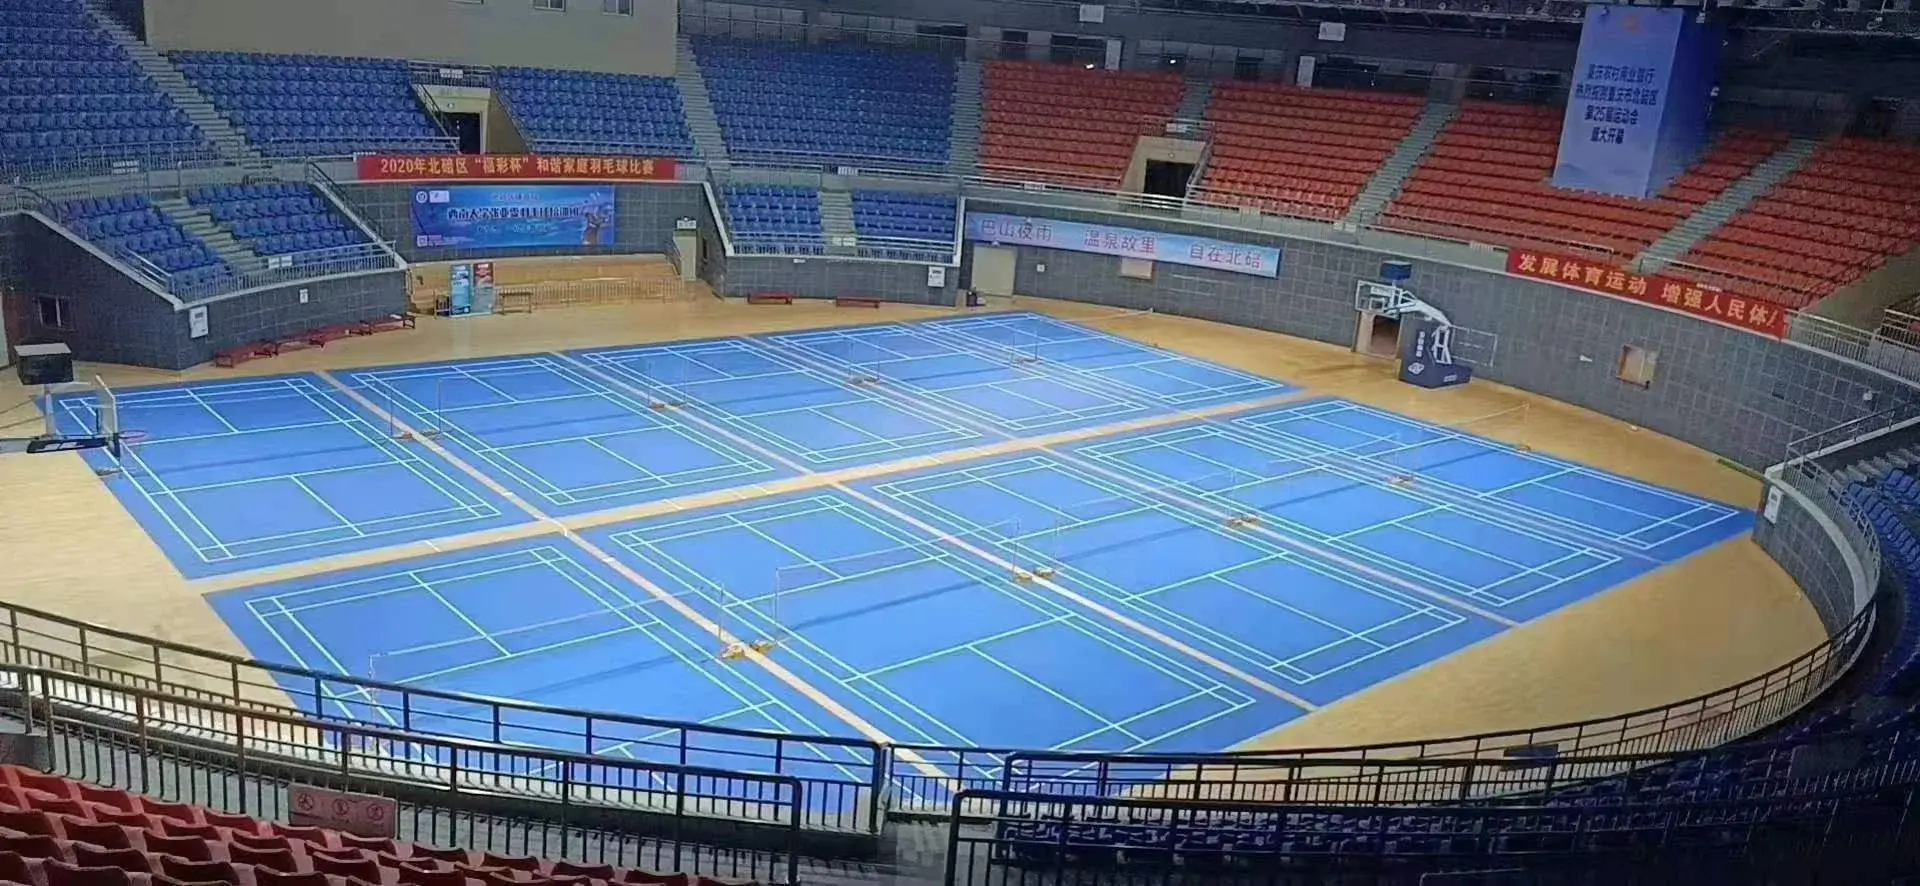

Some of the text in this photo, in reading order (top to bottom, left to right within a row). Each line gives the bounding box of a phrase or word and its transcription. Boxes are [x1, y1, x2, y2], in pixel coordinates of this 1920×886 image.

[980, 219, 1262, 268] 巴山夜雨 温泉故里 自在北碚
[1517, 253, 1648, 297] 发展体育运动
